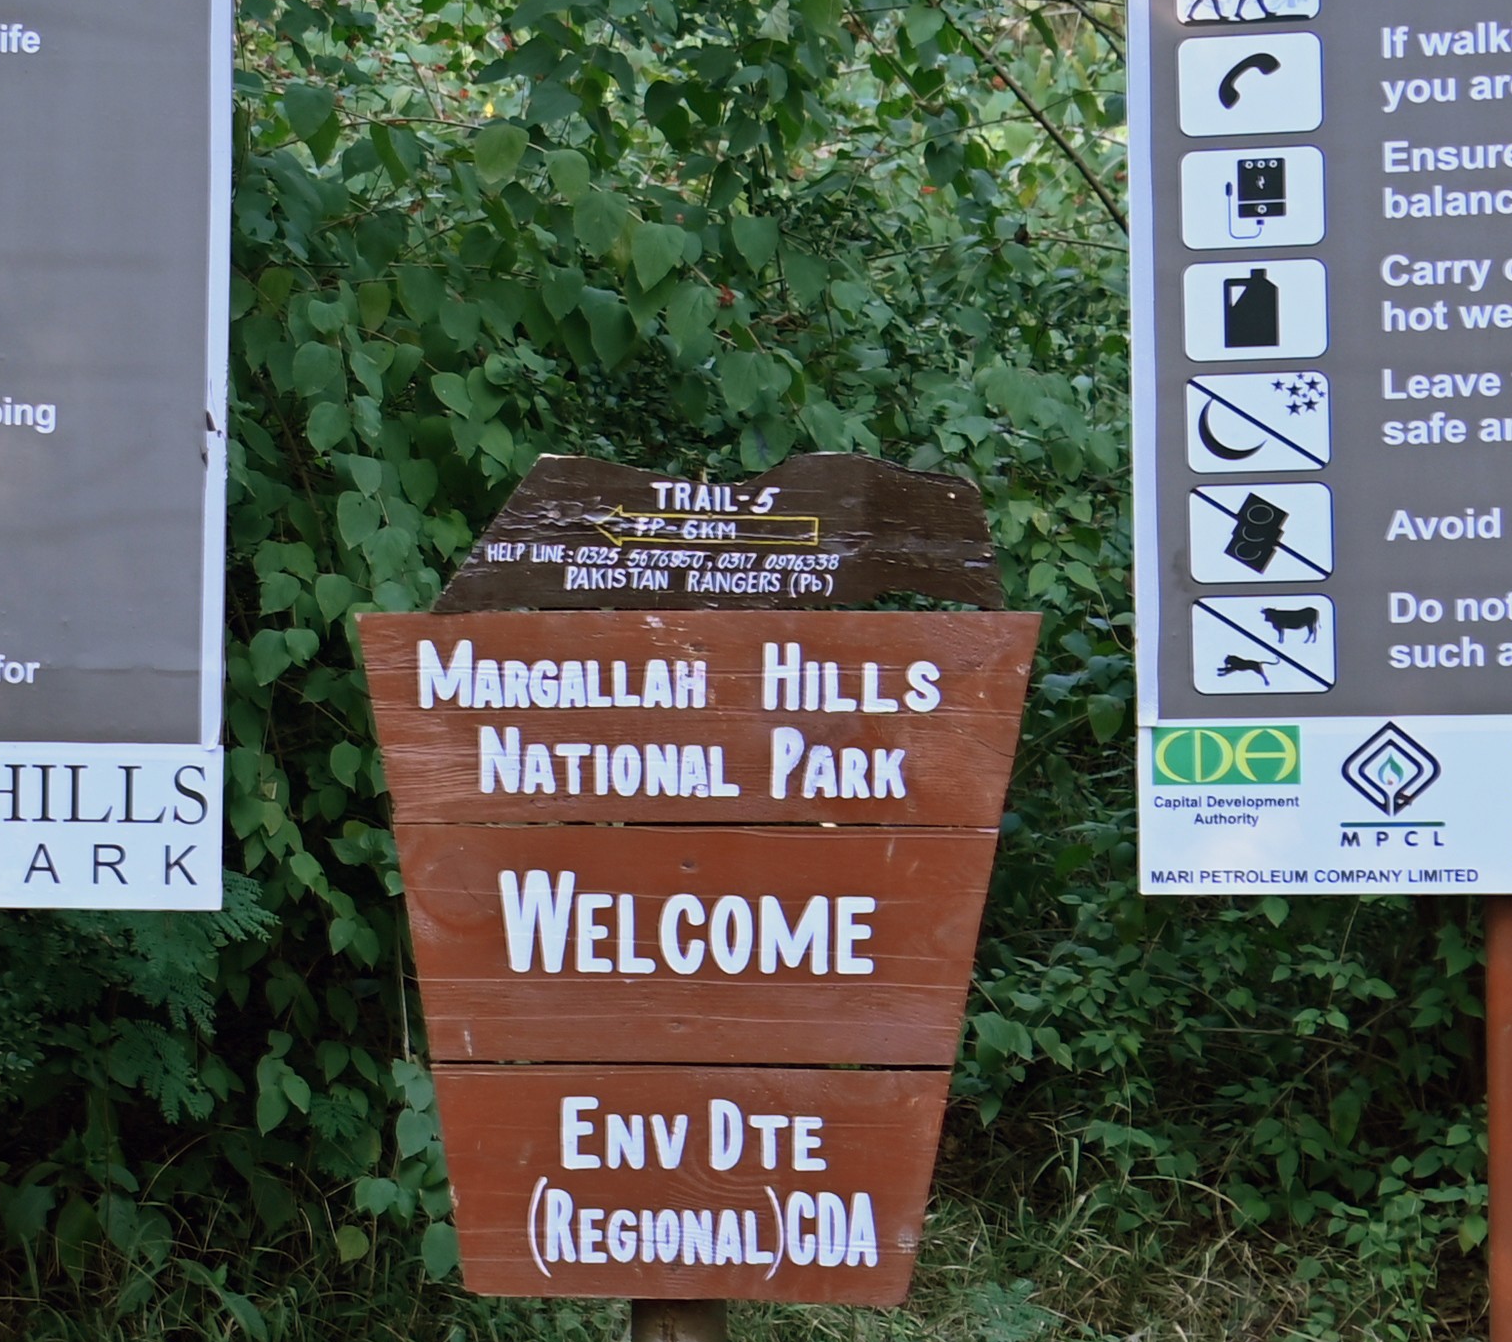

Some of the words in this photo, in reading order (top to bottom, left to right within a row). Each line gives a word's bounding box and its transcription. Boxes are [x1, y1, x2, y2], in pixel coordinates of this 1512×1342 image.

[564, 566, 669, 591] PAKISTAN
[685, 570, 781, 594] RANGERS
[1389, 591, 1443, 624] Do
[1389, 635, 1485, 669] such
[416, 638, 708, 711] MARGALLAH
[761, 641, 942, 714] HILLS
[478, 725, 740, 798] NATIONAL
[769, 727, 907, 800] PARK
[1154, 795, 1202, 811] Capital
[1206, 795, 1299, 811] Development
[1194, 812, 1259, 828] Authority
[1341, 830, 1443, 846] MPCL
[1152, 870, 1193, 883] MARI
[1200, 870, 1307, 883] PETROLEUM
[1315, 870, 1401, 883] COMPANY
[1409, 868, 1478, 883] LIMITED
[499, 869, 877, 976] WELCOME
[559, 1096, 689, 1171] ENV
[708, 1098, 828, 1172] DTE
